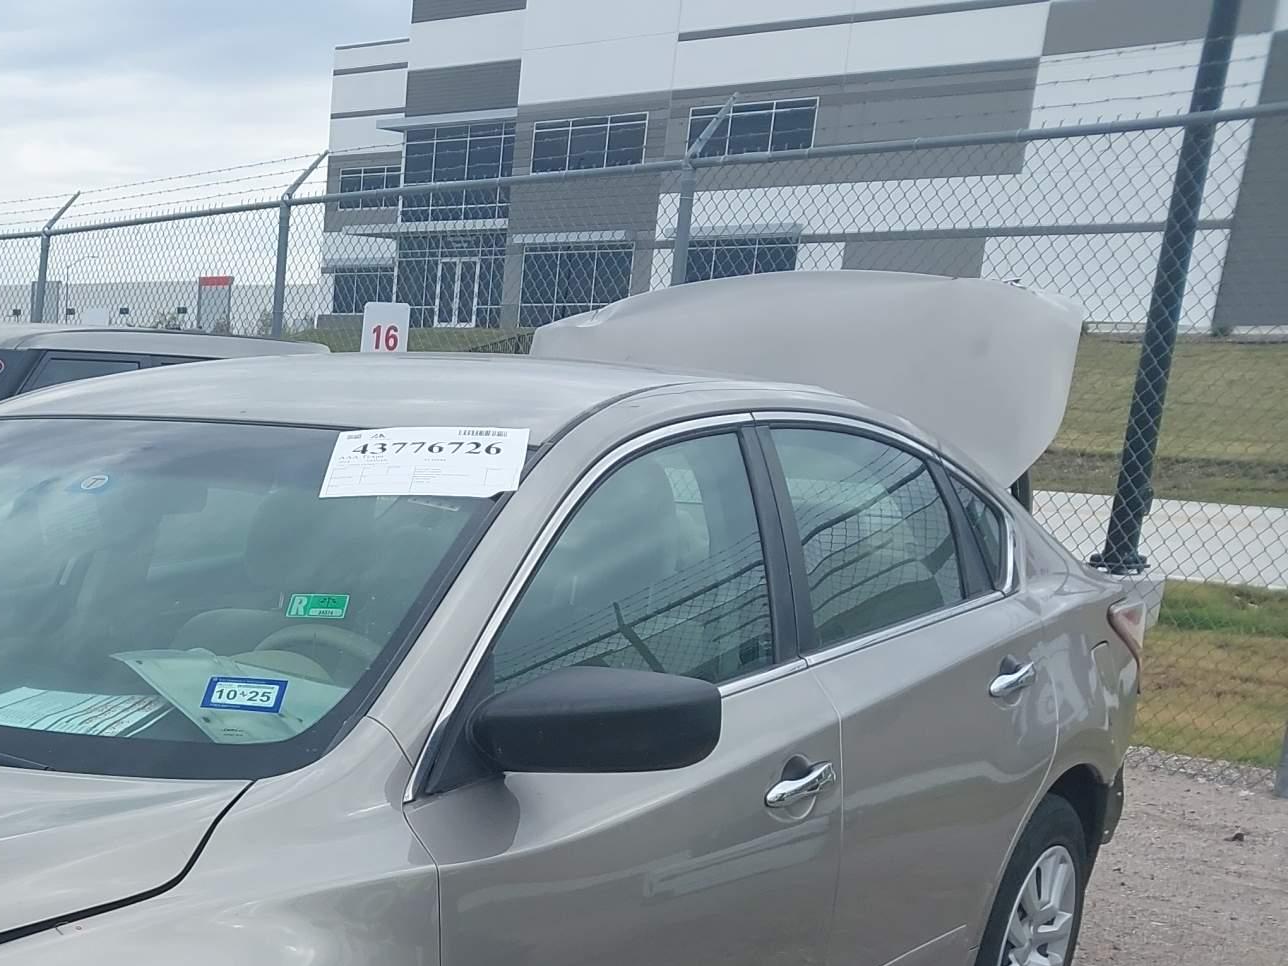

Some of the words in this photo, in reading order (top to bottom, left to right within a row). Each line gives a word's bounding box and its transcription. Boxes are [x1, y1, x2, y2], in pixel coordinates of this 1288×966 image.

[372, 324, 399, 351] 16
[351, 441, 504, 456] 43776726
[290, 596, 308, 616] R
[216, 688, 238, 701] 10
[246, 690, 272, 702] 25
